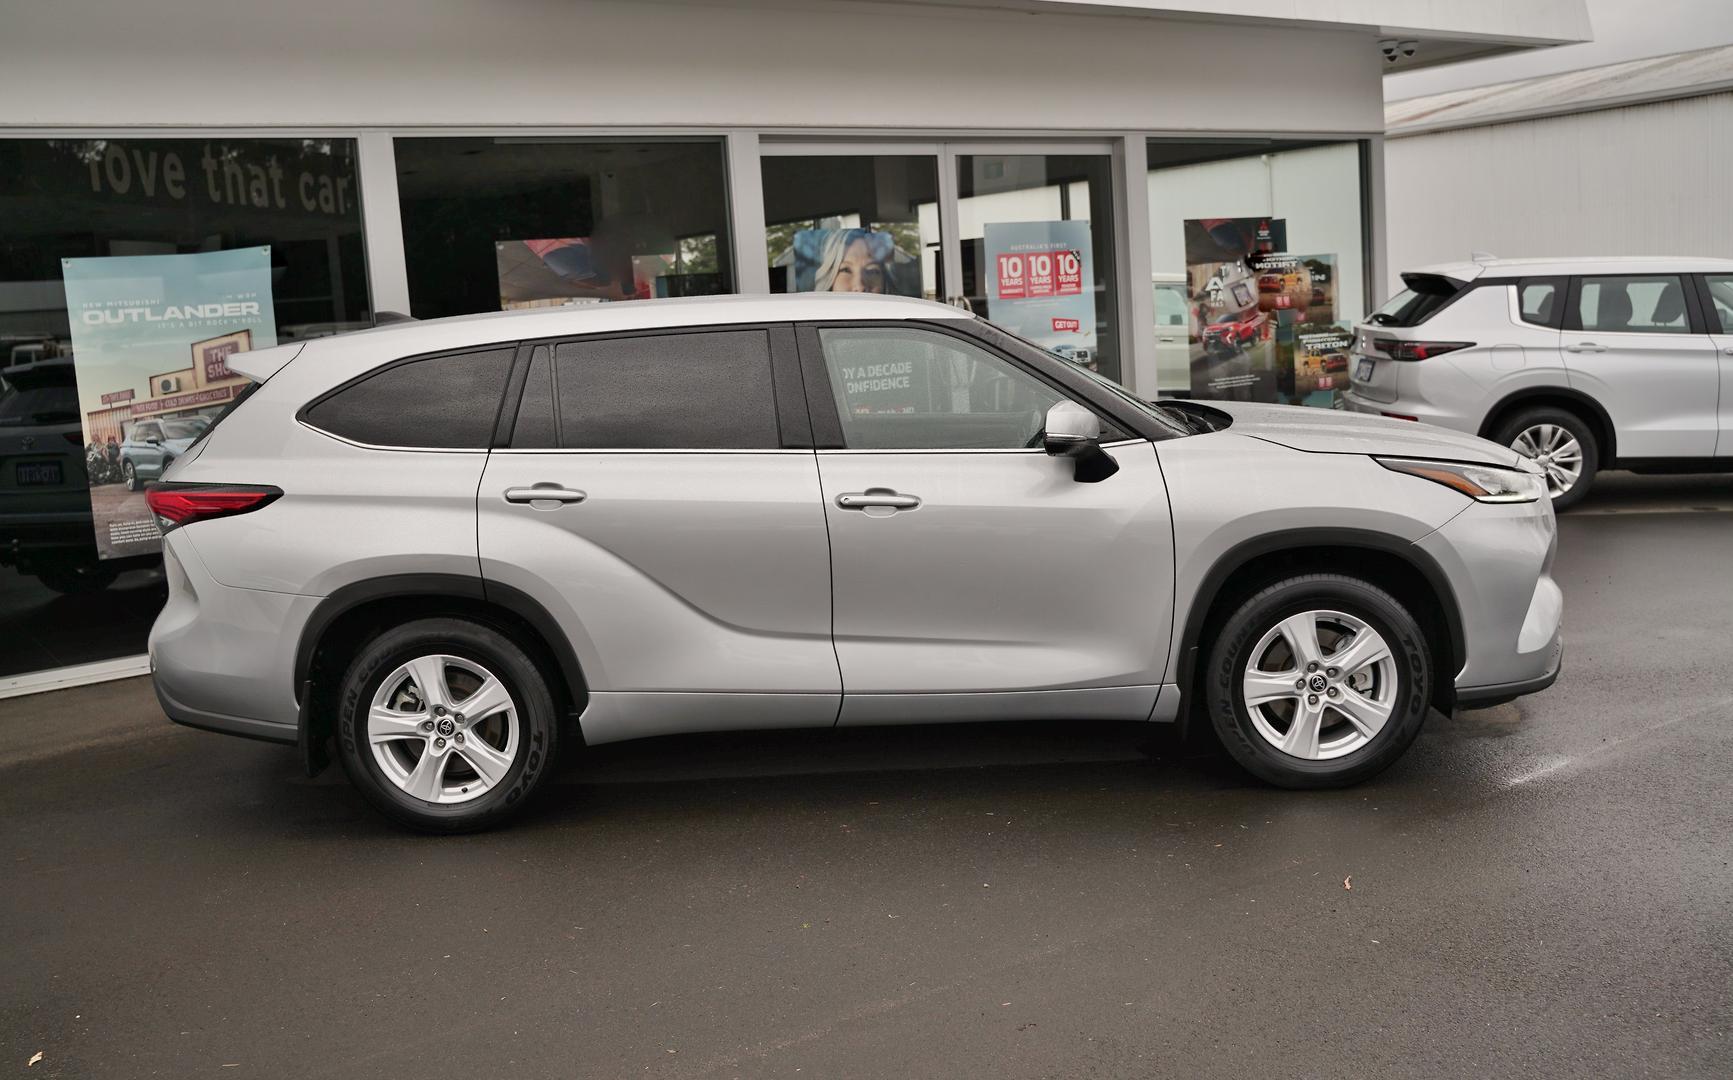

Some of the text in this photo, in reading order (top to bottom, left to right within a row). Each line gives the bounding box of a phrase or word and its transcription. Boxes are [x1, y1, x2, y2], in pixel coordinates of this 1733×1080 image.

[201, 143, 286, 208] that
[1000, 257, 1022, 278] 10
[1028, 255, 1051, 277] 10
[1057, 254, 1079, 275] 10
[1001, 278, 1023, 286] YEARS
[1030, 275, 1051, 284] YEARS
[1058, 274, 1079, 283] YEARS
[82, 301, 260, 325] OUTLANDER
[867, 361, 912, 378] DECADE
[847, 376, 911, 394] ONFIDENCE
[1403, 634, 1424, 714] TOYO
[505, 731, 544, 804] TOYO
